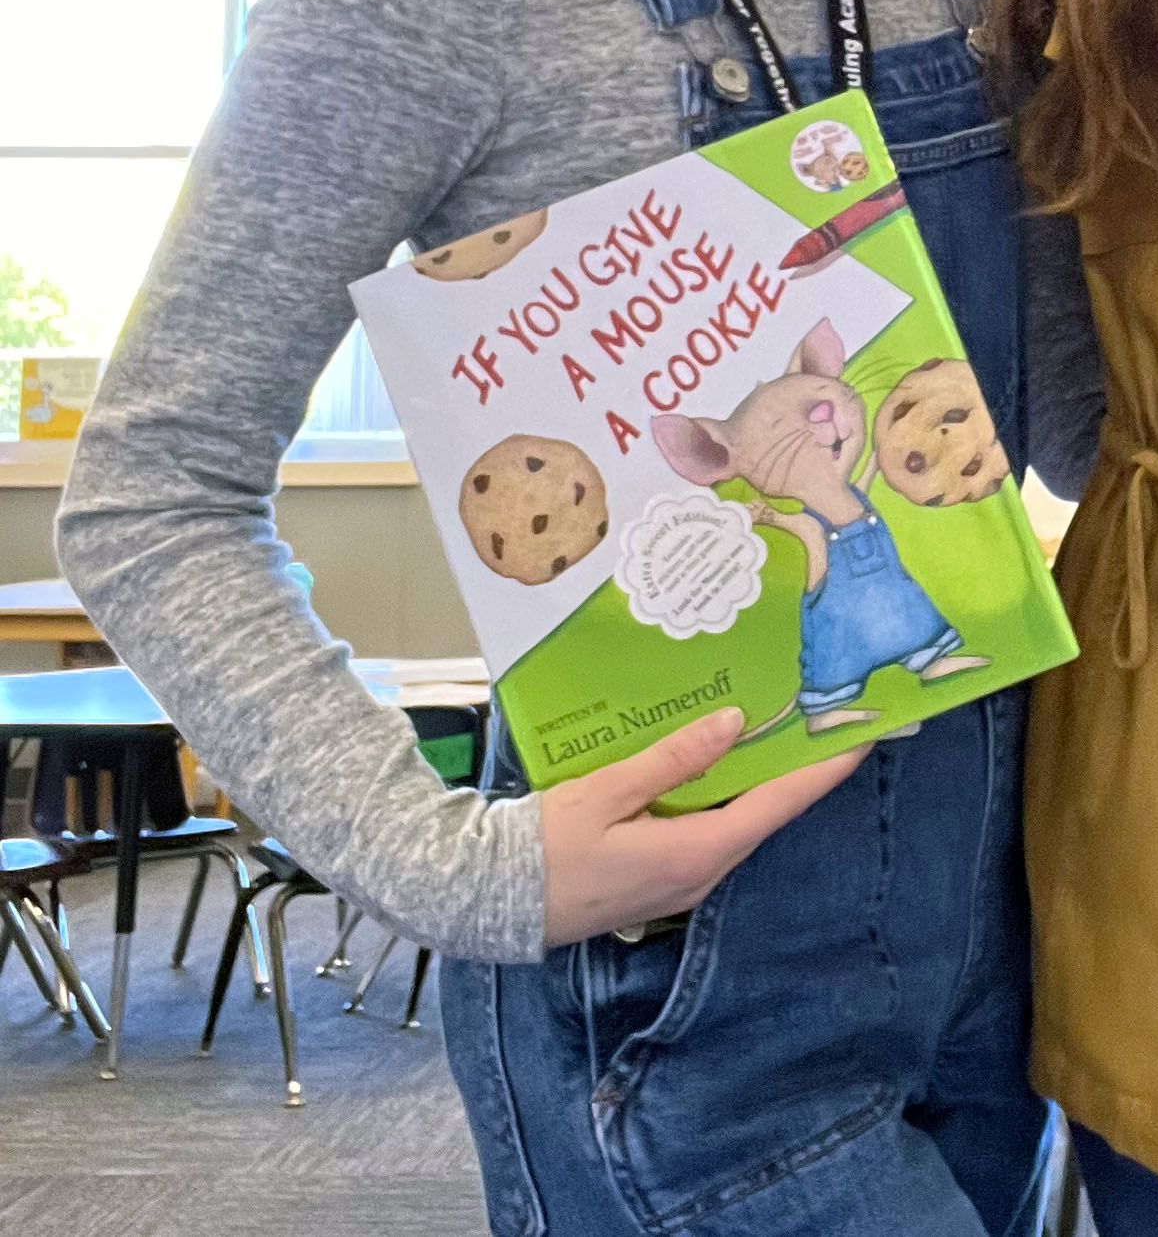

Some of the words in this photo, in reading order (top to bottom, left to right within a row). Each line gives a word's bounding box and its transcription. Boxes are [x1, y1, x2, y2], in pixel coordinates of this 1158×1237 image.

[452, 334, 504, 405] IF
[498, 267, 579, 354] YOU
[579, 188, 682, 285] GIVE
[561, 354, 596, 402] A
[591, 231, 734, 365] MOUSE
[605, 410, 641, 455] A
[643, 262, 786, 411] COOKIE
[542, 725, 617, 765] Laura
[618, 667, 733, 737] Numeroff
